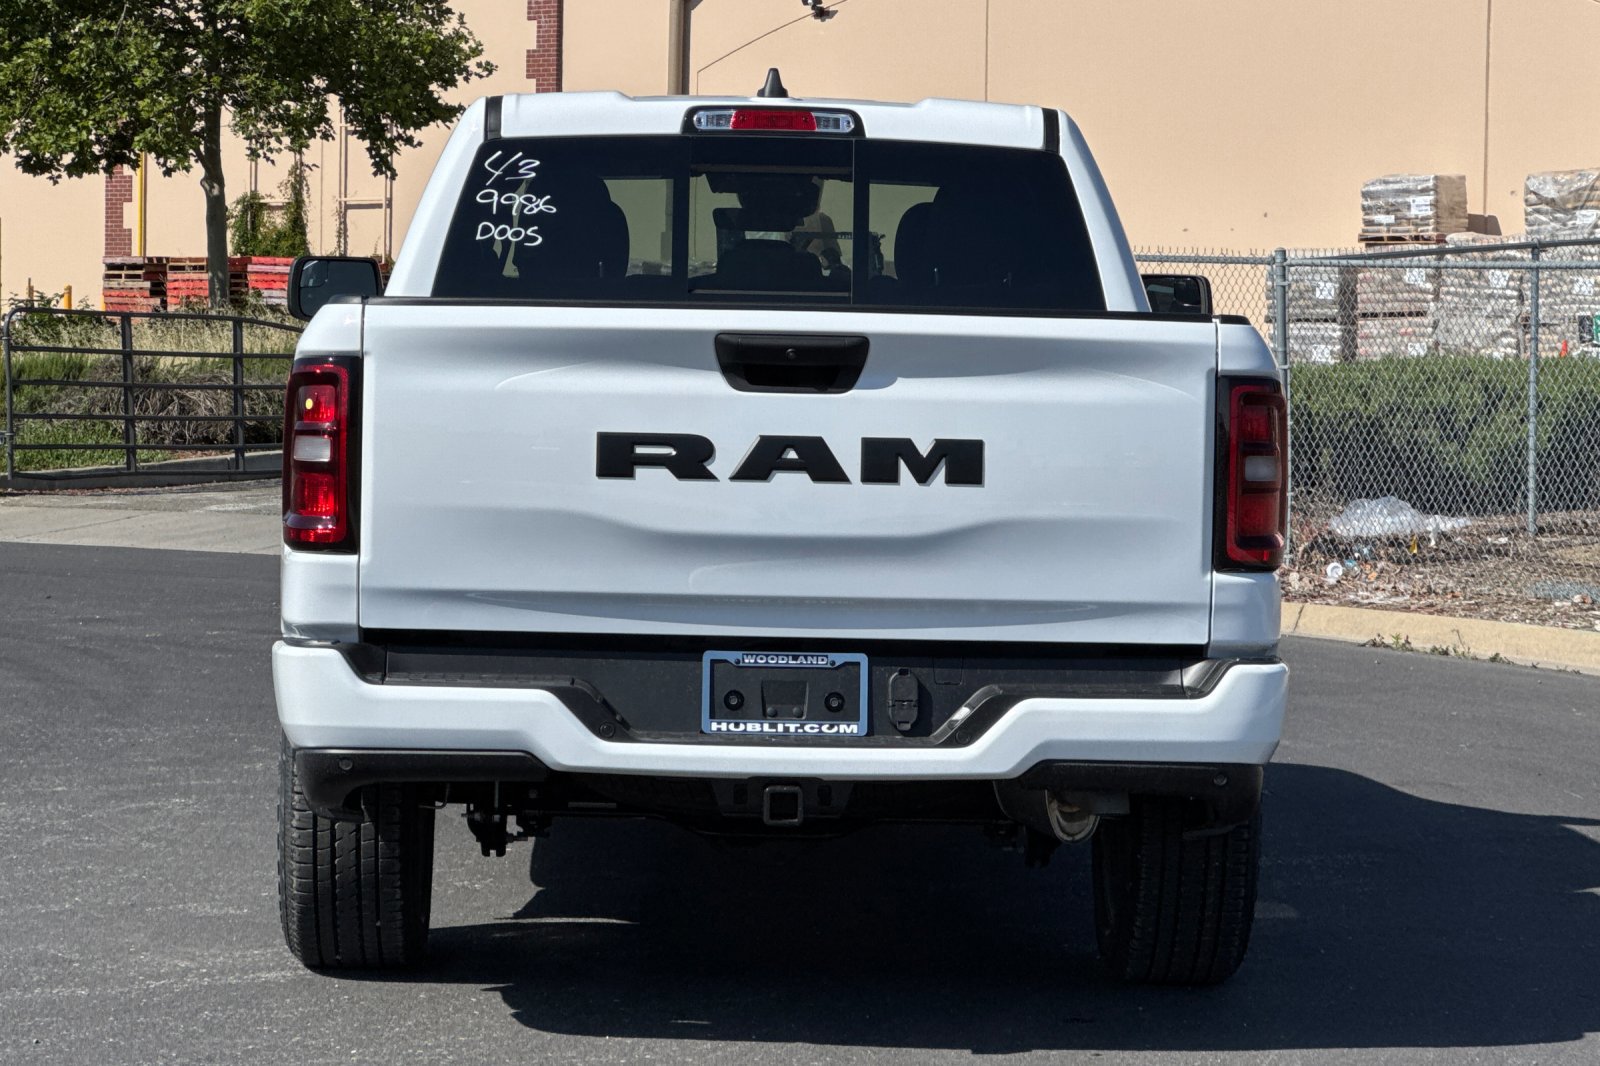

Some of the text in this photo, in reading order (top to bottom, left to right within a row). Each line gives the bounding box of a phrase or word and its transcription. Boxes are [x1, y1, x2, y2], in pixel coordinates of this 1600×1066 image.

[476, 189, 557, 216] 9986
[596, 431, 984, 487] RAM
[743, 654, 829, 665] WOODLAND
[710, 721, 859, 734] HUBLIT.COM
